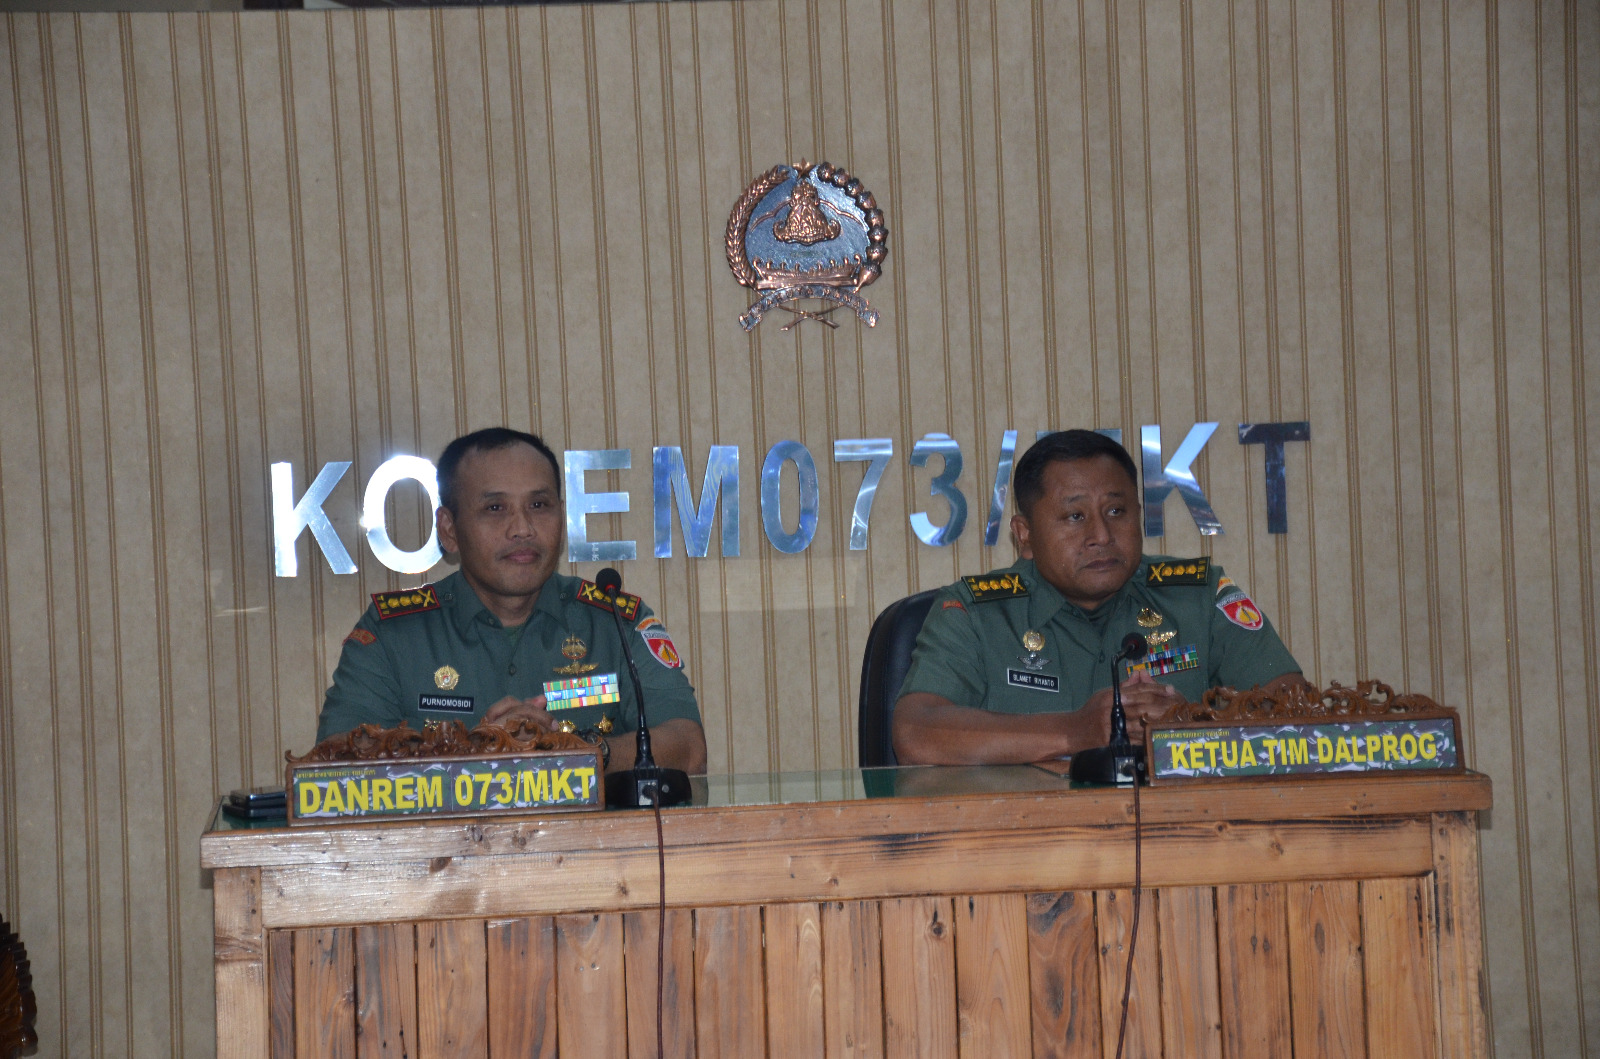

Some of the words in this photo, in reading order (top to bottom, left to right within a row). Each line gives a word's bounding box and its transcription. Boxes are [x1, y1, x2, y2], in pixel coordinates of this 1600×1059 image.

[271, 445, 740, 577] KOEM
[761, 421, 1310, 554] 073/KT
[422, 697, 471, 708] PURNOMOSIDI
[1171, 740, 1257, 769] KETUA
[1263, 738, 1309, 766] TIM
[1317, 733, 1437, 764] DALPROG
[299, 776, 443, 814] DANREM
[455, 767, 595, 807] 073/MKT
